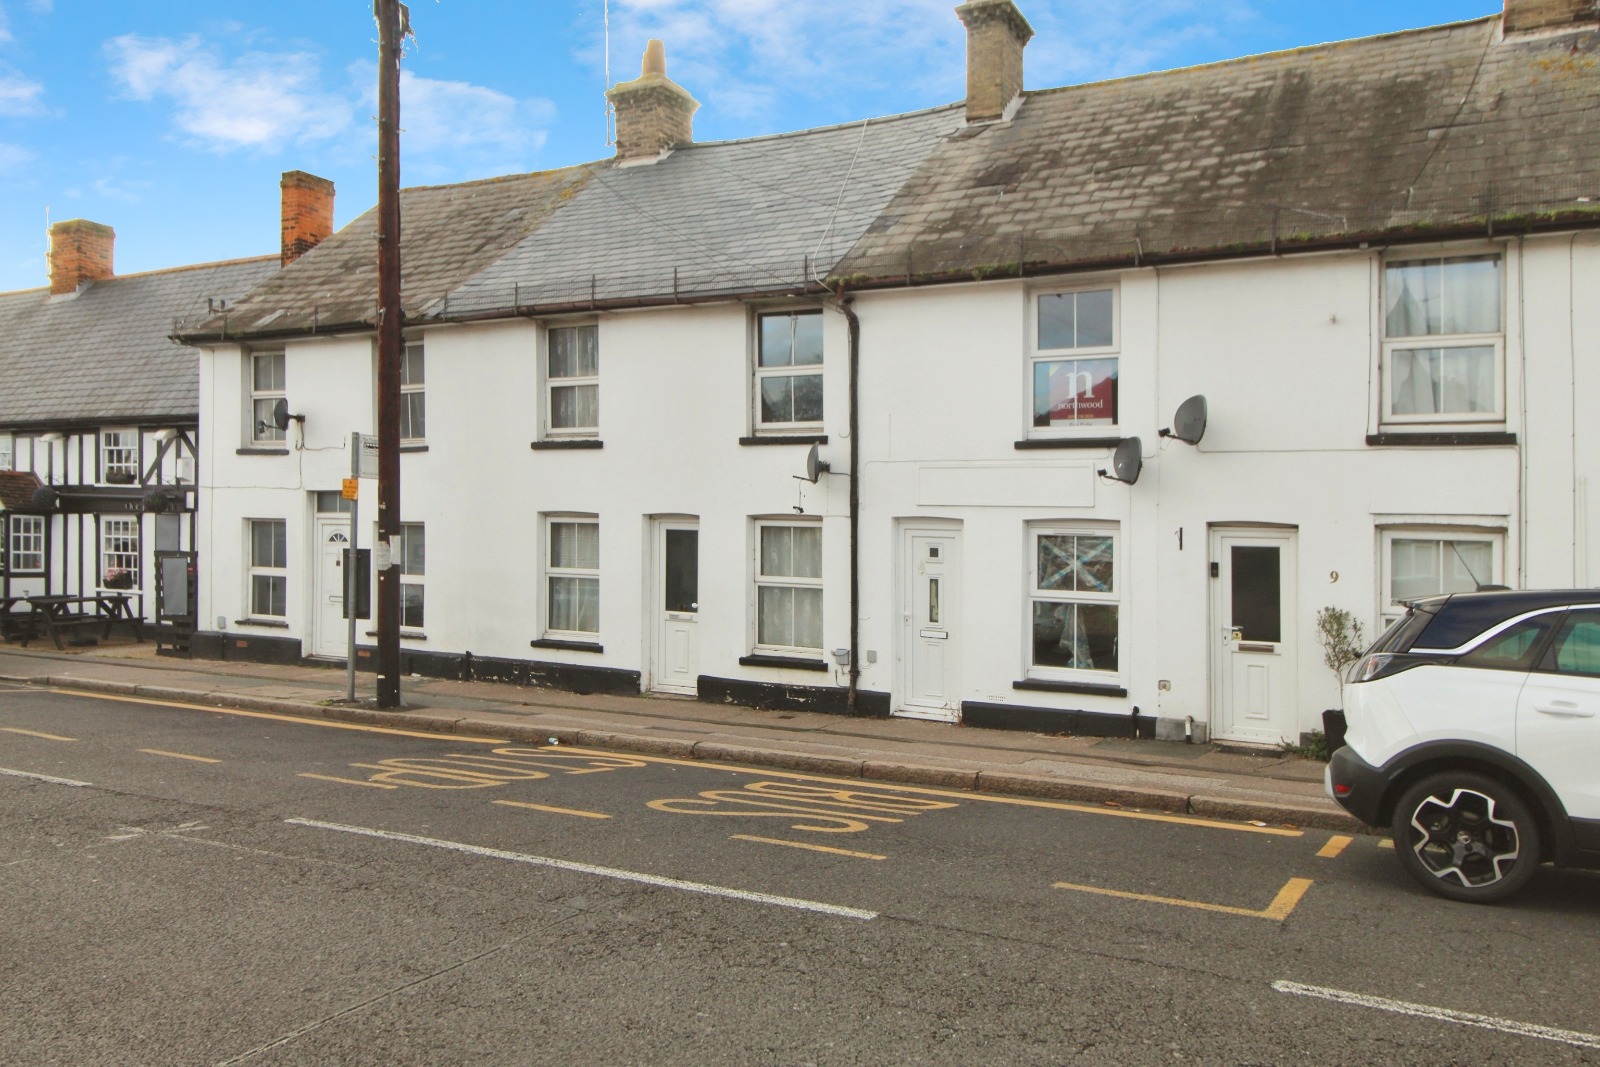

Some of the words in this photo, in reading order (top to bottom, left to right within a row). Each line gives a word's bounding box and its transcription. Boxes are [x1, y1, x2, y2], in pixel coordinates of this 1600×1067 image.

[1065, 370, 1095, 399] n
[1329, 570, 1339, 584] 9
[348, 747, 647, 789] STOP
[645, 781, 959, 833] BUS
